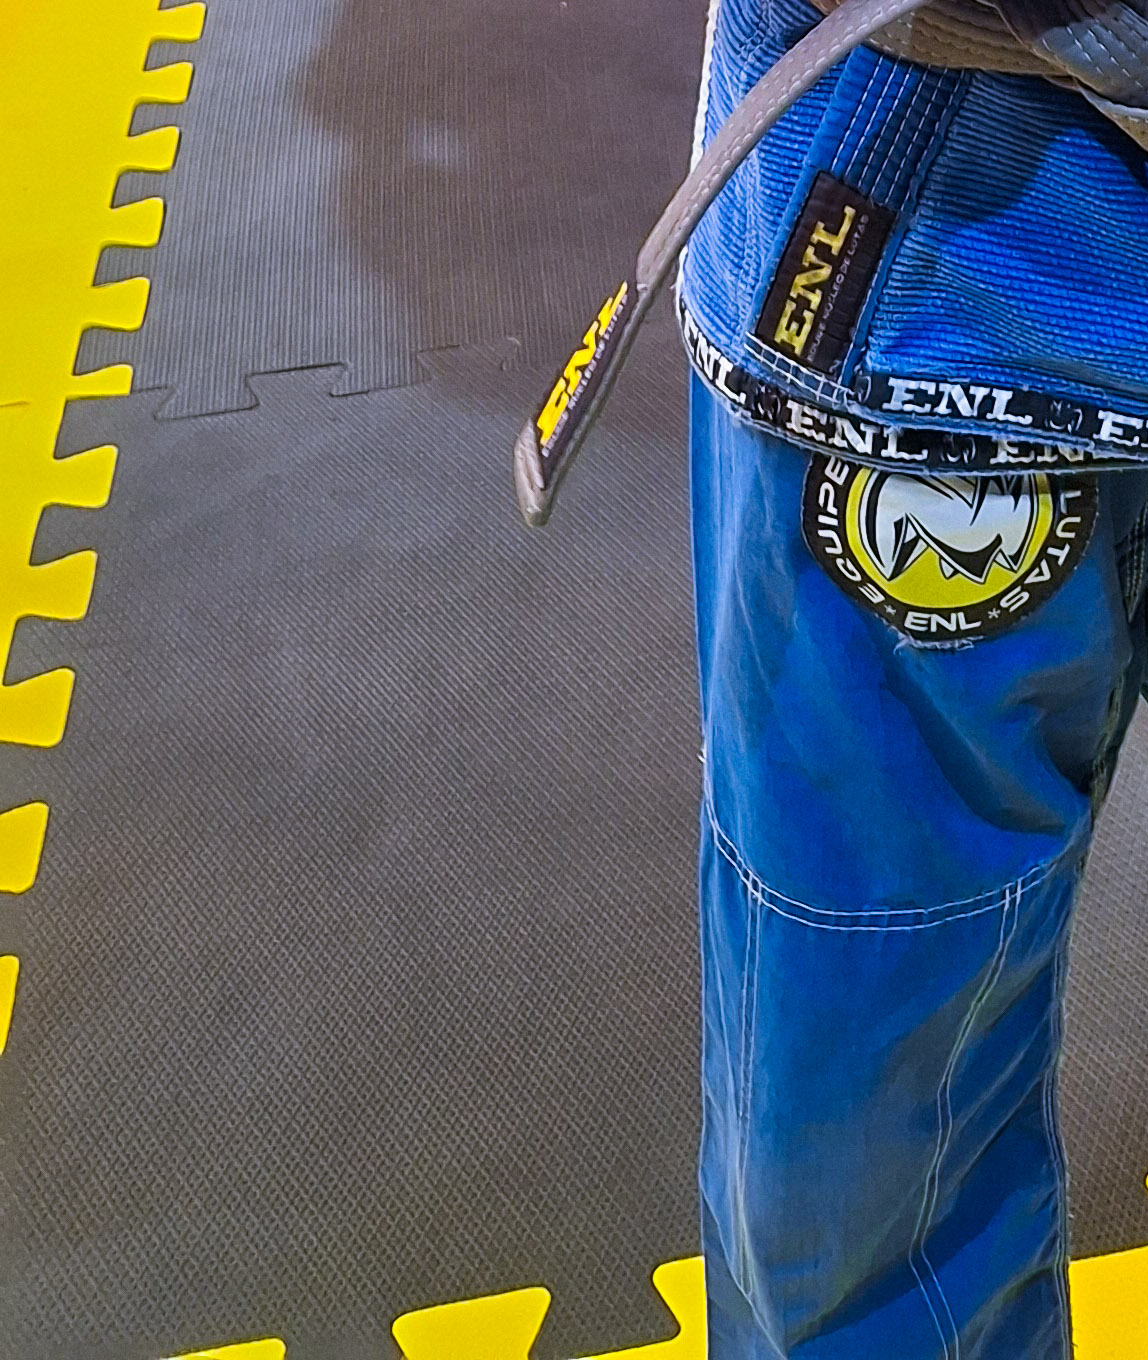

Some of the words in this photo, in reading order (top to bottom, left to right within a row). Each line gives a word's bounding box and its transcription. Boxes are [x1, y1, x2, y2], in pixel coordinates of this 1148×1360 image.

[774, 205, 856, 357] ENL
[537, 280, 628, 447] ENL
[684, 308, 747, 405] ENL
[785, 399, 928, 462] ENL
[882, 378, 1033, 425] ENL
[817, 456, 886, 604] EQUIPE
[999, 489, 1082, 613] LUTAS
[904, 610, 982, 633] ENL
